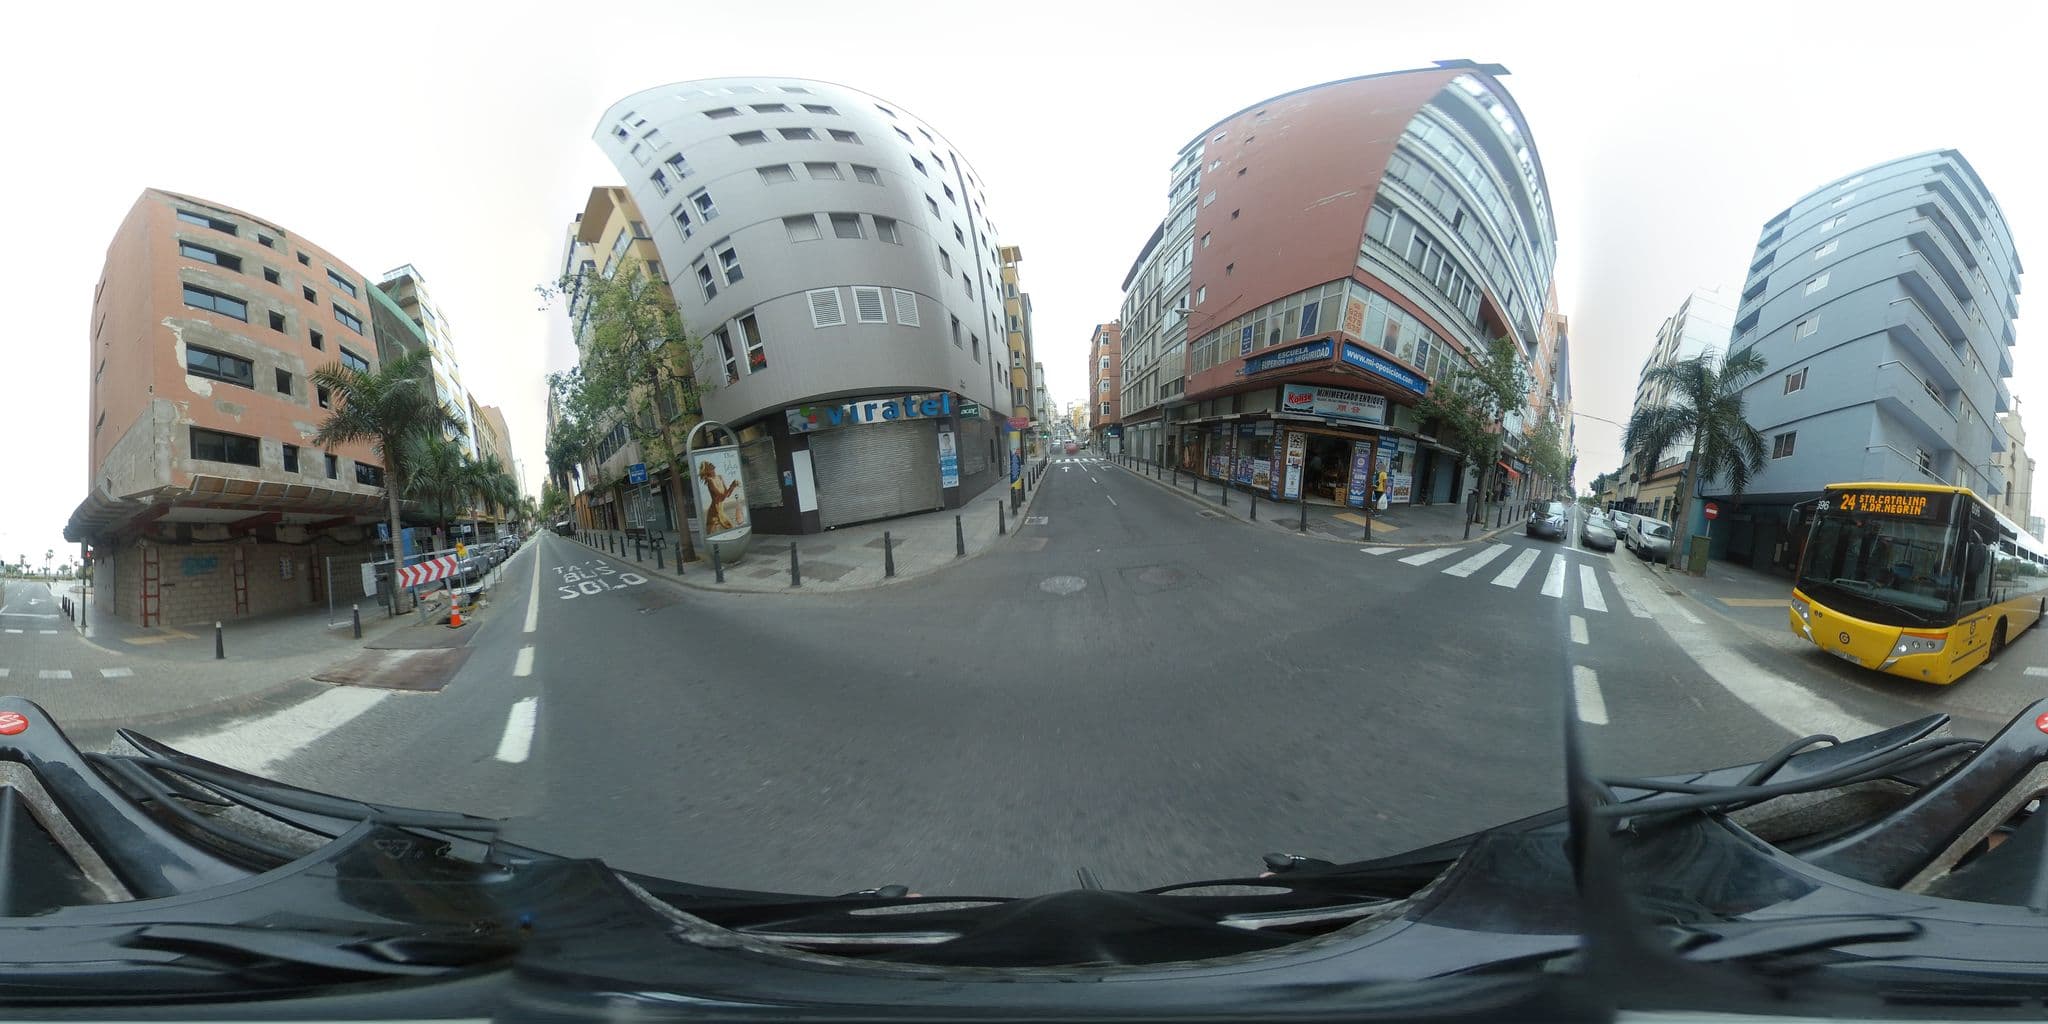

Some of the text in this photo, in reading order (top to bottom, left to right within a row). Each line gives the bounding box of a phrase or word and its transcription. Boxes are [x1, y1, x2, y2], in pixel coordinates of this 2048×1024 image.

[1261, 359, 1286, 370] SUPERIOR
[1295, 347, 1330, 363] SEGURIDAD
[1278, 347, 1308, 359] ESCUELA
[1346, 349, 1414, 384] www.mi-oposicion.com
[1316, 388, 1358, 402] MINIMERCADO
[1359, 394, 1384, 406] ENRIQUE
[826, 392, 950, 426] viratel
[1840, 494, 1927, 510] 24 STA.CATALINA
[1861, 503, 1922, 516] H.DR.NEGRIN
[563, 566, 616, 583] BUS
[558, 573, 648, 599] SOLO
